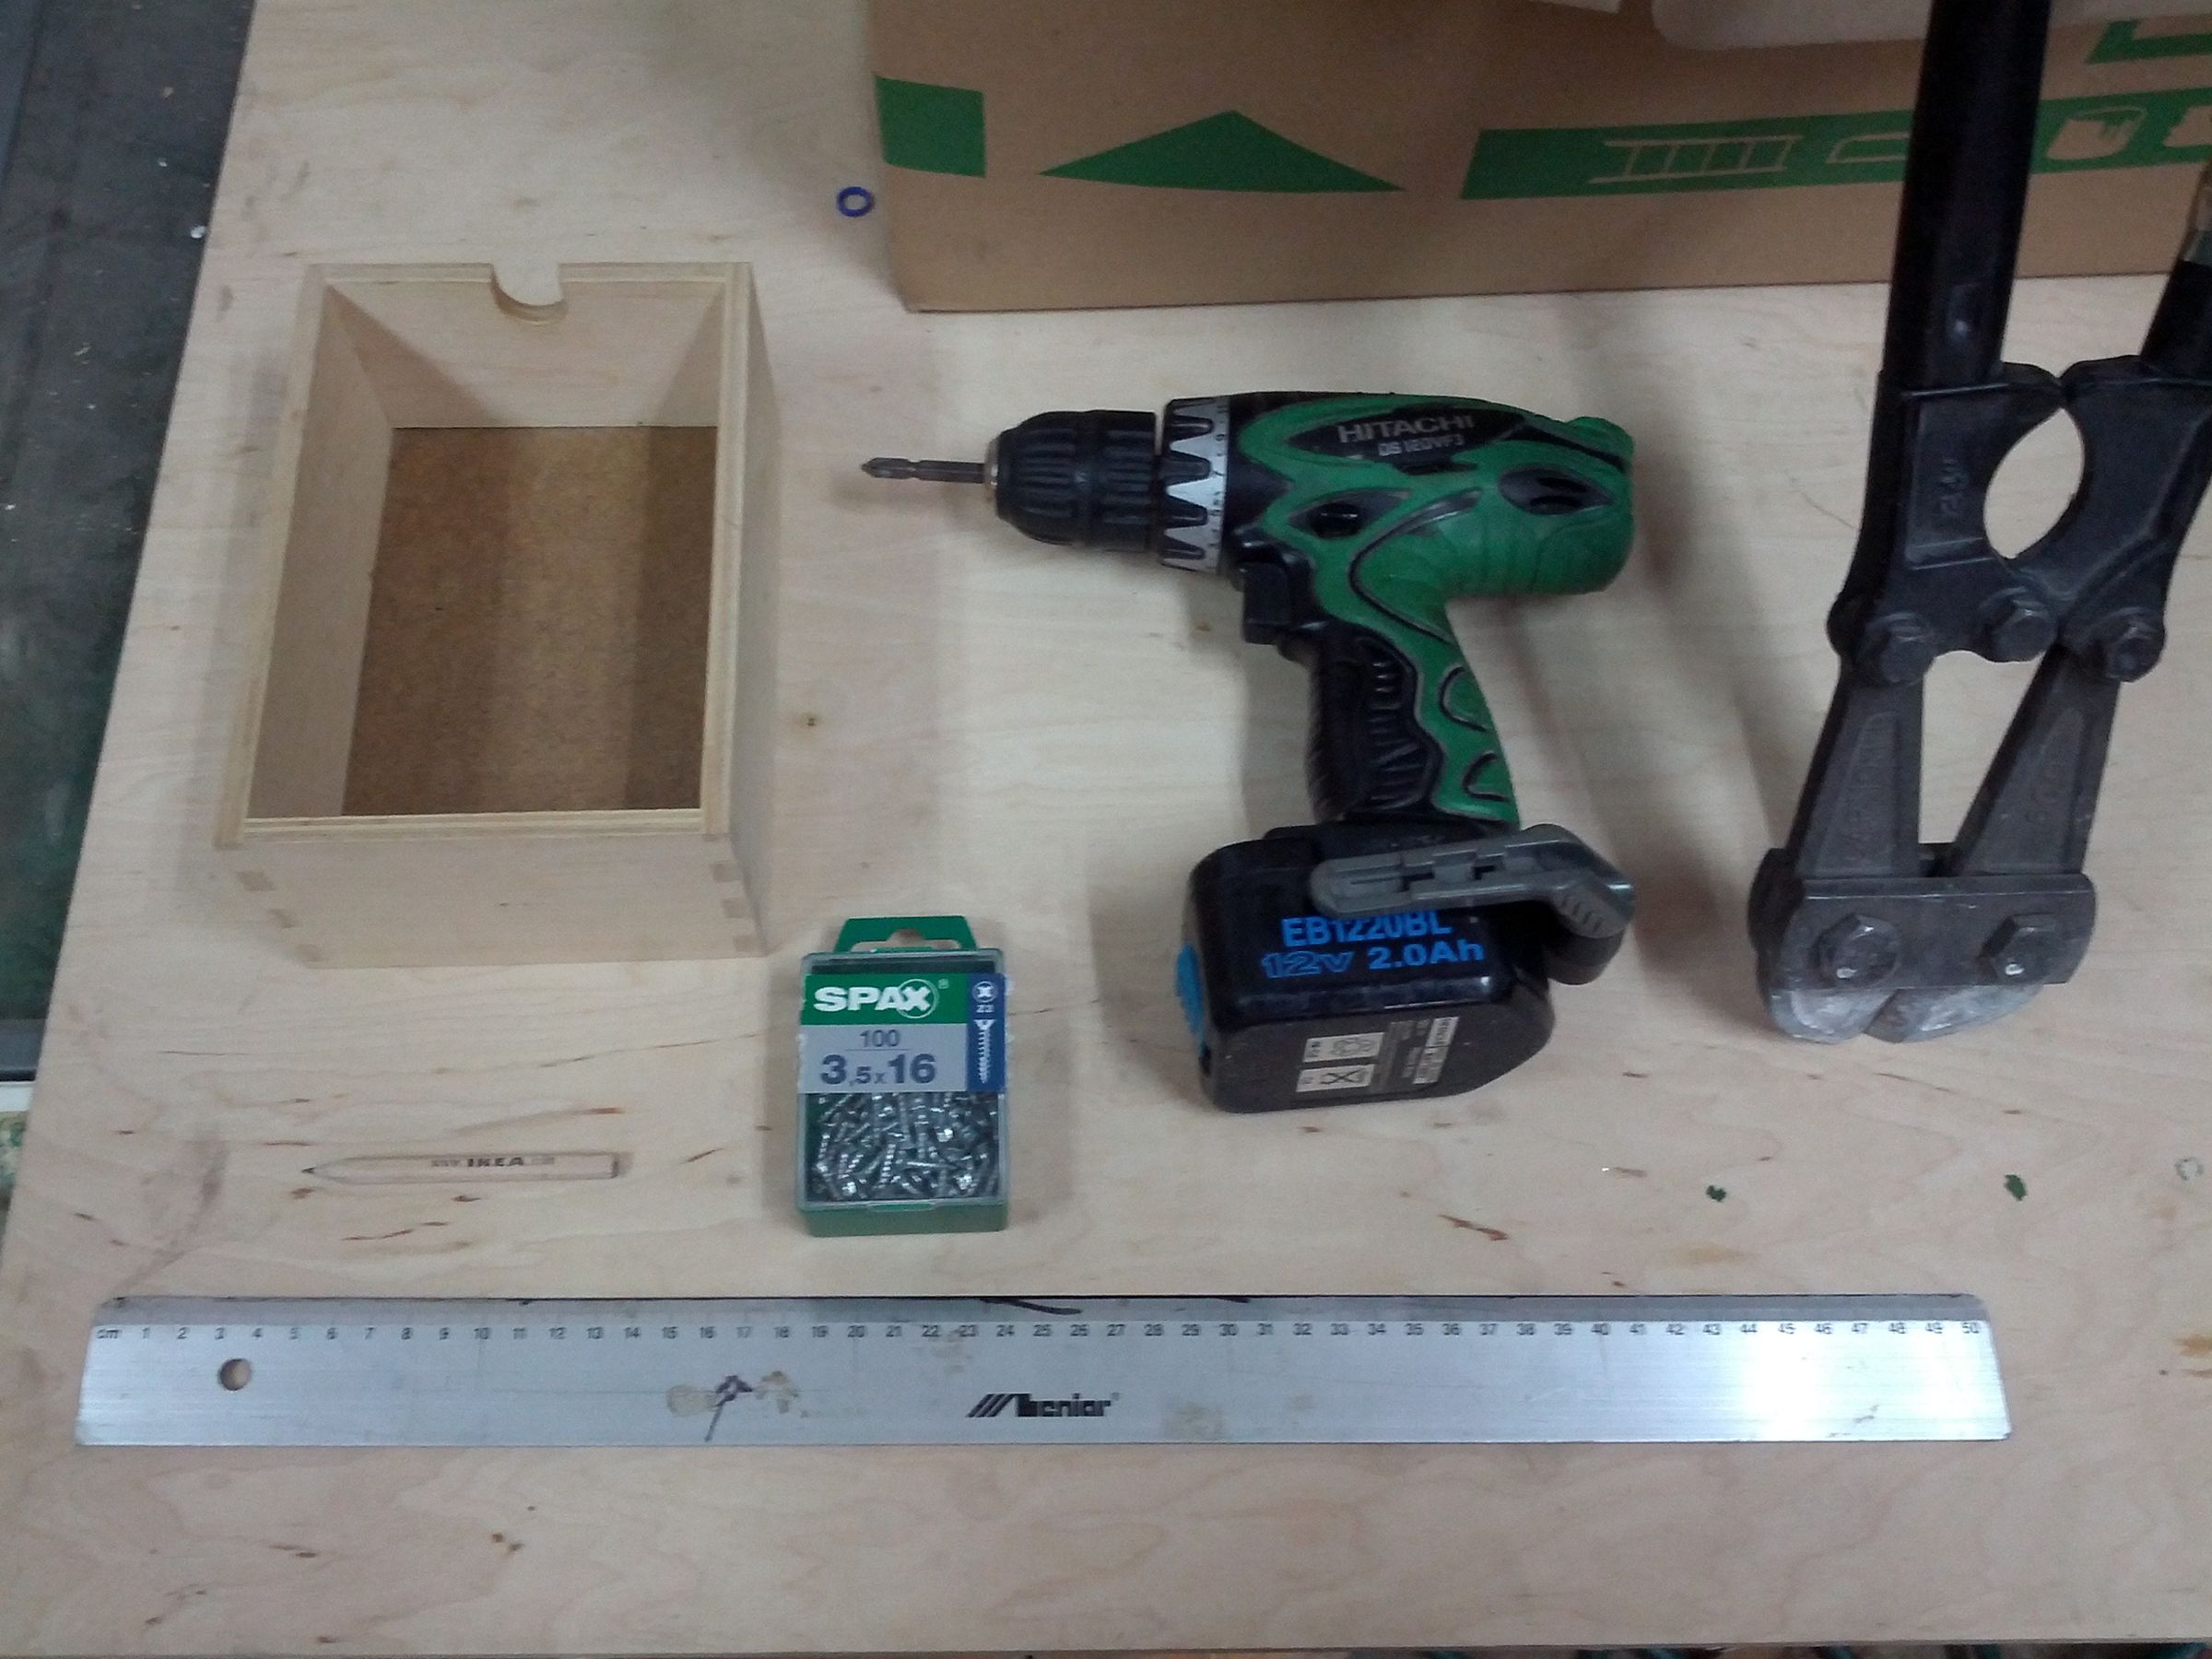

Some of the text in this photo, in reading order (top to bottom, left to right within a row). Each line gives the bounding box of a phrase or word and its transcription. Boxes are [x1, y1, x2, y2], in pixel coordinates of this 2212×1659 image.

[1338, 416, 1474, 443] HITACHI
[1370, 938, 1486, 970] 2.0Ah
[814, 986, 931, 1012] SPAX
[860, 1030, 900, 1048] 100
[467, 1157, 525, 1168] IKEA
[177, 1327, 190, 1339] 2
[214, 1327, 227, 1339] 3
[252, 1327, 265, 1339] 4
[289, 1327, 301, 1339] 5
[327, 1326, 340, 1339] 6
[364, 1326, 376, 1339] 7
[401, 1326, 414, 1339] 8
[439, 1326, 452, 1338] 9
[475, 1326, 492, 1338] 10
[513, 1326, 527, 1338] 11
[549, 1326, 567, 1338] 12
[587, 1326, 605, 1338] 13
[624, 1326, 641, 1338] 14
[662, 1326, 679, 1338] 15
[699, 1325, 716, 1338] 16
[736, 1325, 754, 1337] 17
[773, 1325, 791, 1337] 18
[811, 1325, 829, 1337] 19
[848, 1325, 865, 1337] 20
[885, 1325, 902, 1337] 21
[923, 1325, 940, 1337] 22
[959, 1325, 977, 1337] 23
[996, 1325, 1014, 1336] 24
[1034, 1325, 1052, 1336] 25
[1071, 1325, 1088, 1336] 26
[1108, 1324, 1125, 1336] 27
[1146, 1324, 1163, 1336] 28
[1182, 1324, 1200, 1336] 29
[1220, 1324, 1237, 1336] 30
[1258, 1324, 1273, 1336] 31
[1293, 1324, 1312, 1335] 32
[1331, 1324, 1349, 1335] 33
[1368, 1324, 1386, 1335] 34
[1406, 1324, 1423, 1335] 35
[1442, 1324, 1461, 1335] 36
[1479, 1324, 1498, 1335] 37
[1517, 1324, 1535, 1335] 38
[1554, 1324, 1572, 1335] 39
[1592, 1324, 1610, 1335] 40
[1630, 1324, 1646, 1335] 41
[1666, 1324, 1685, 1335] 42
[1703, 1324, 1722, 1335] 43
[1740, 1324, 1758, 1335] 44
[1778, 1324, 1795, 1335] 45
[1815, 1324, 1832, 1335] 46
[1852, 1324, 1868, 1334] 47
[1888, 1324, 1907, 1334] 48
[1925, 1324, 1943, 1334] 49
[1961, 1323, 1980, 1334] 50
